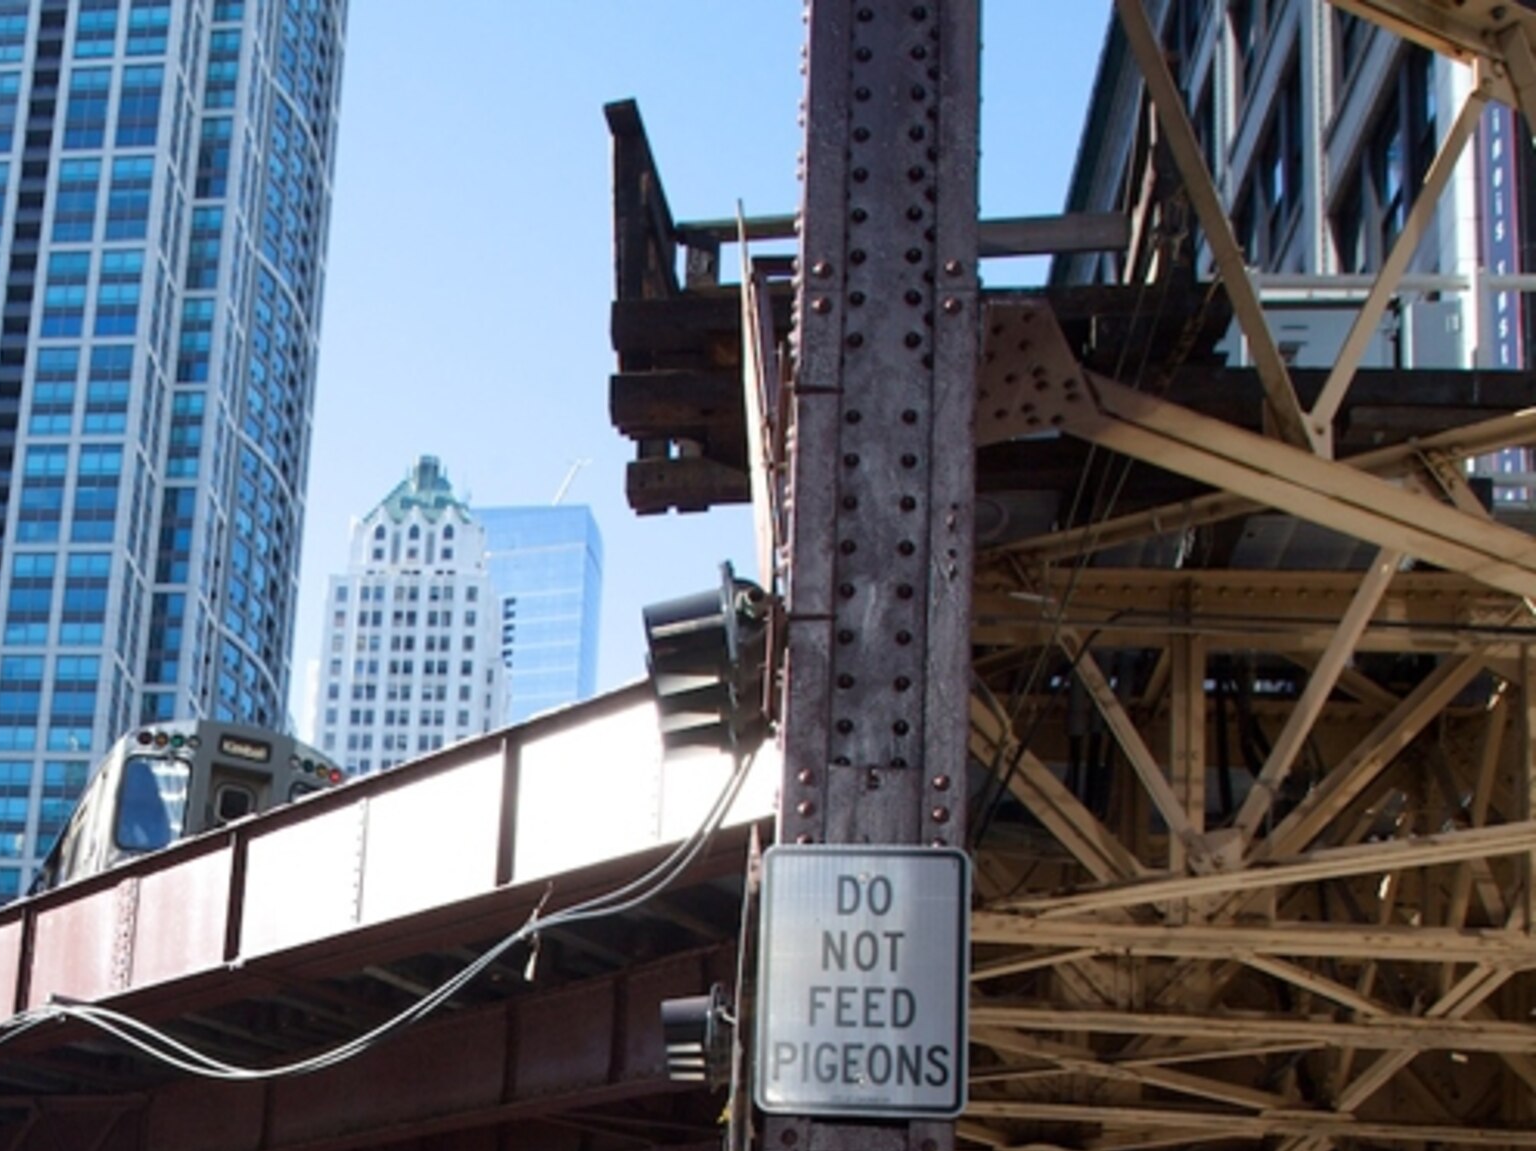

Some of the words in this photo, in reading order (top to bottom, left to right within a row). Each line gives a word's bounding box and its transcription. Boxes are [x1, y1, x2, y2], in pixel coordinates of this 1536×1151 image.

[837, 875, 892, 916] DO
[821, 930, 905, 972] NOT
[808, 986, 916, 1029] FEED
[772, 1042, 950, 1087] PIGEONS
